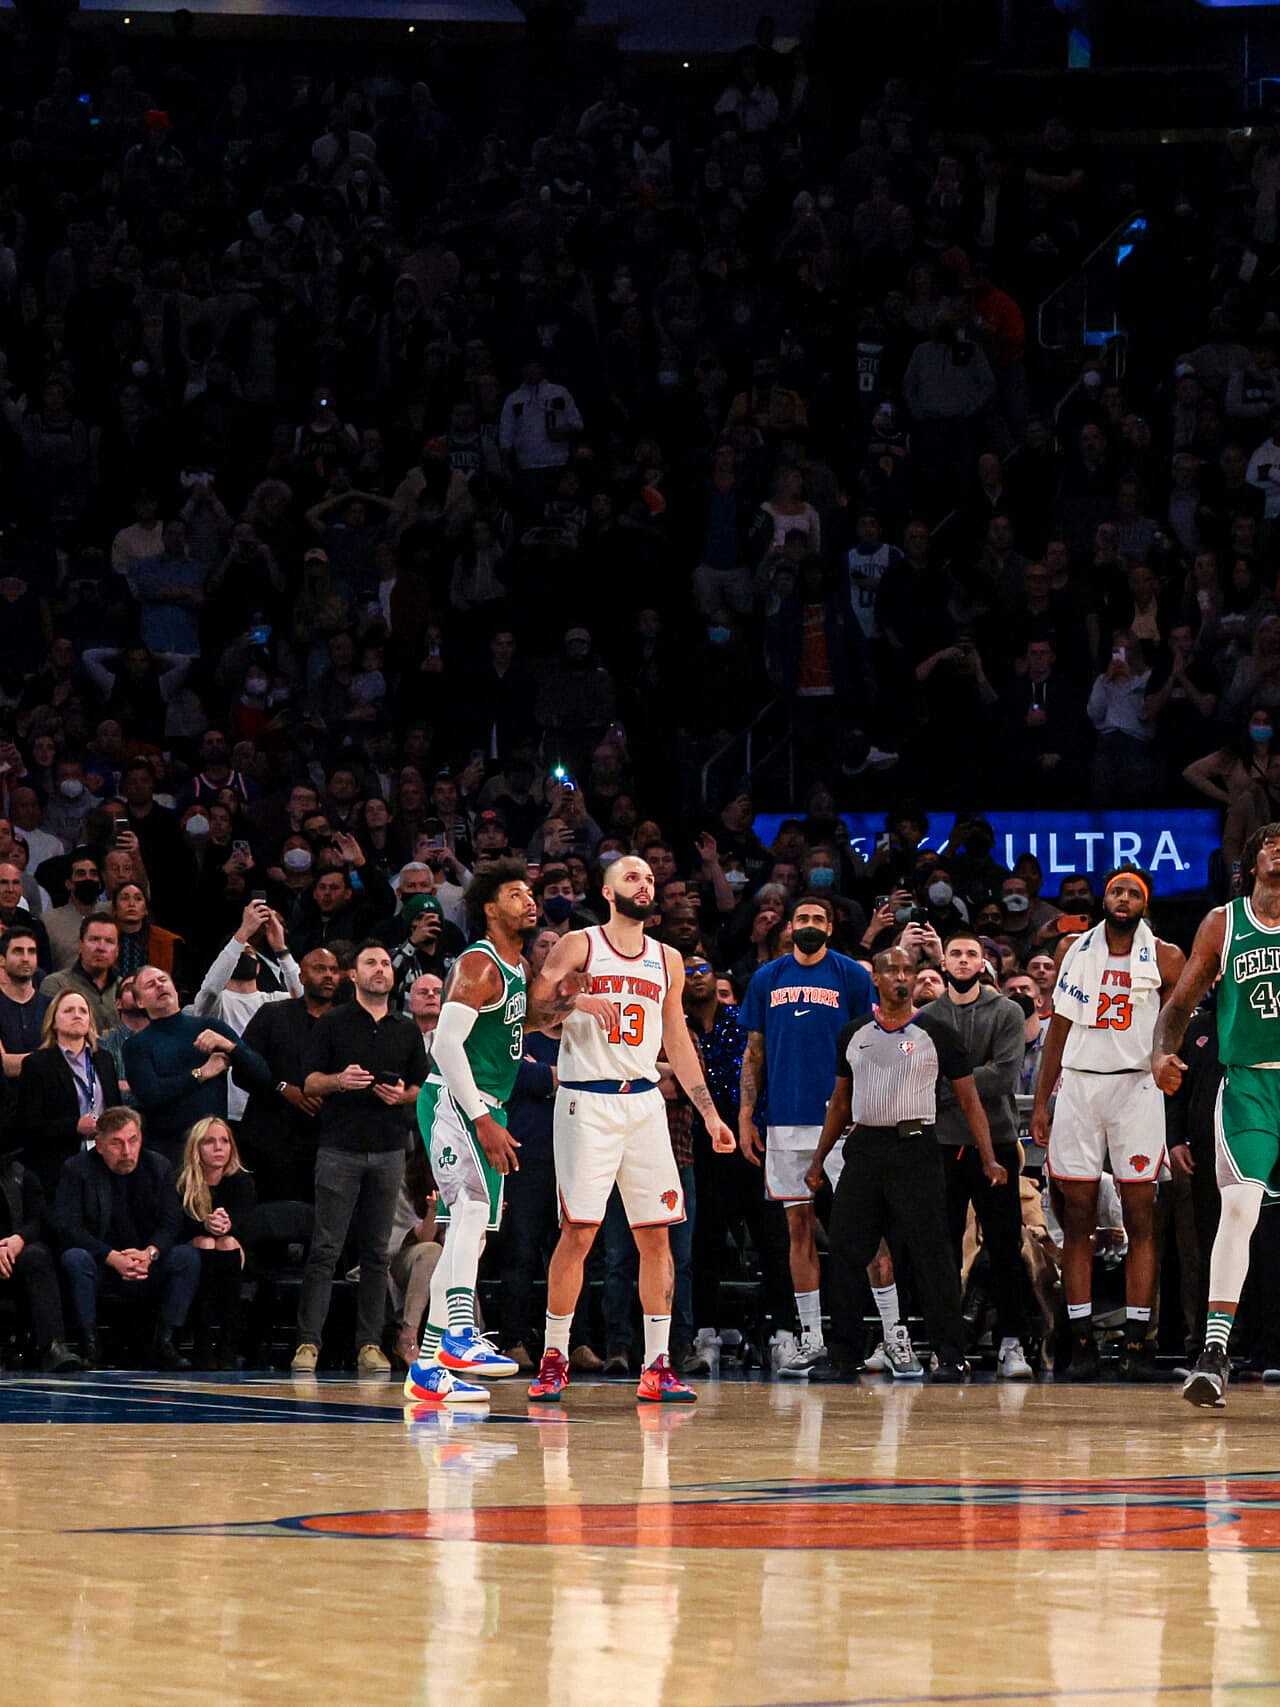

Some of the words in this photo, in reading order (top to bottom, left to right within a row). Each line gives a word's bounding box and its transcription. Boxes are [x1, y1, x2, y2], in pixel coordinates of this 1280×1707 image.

[1005, 829, 1184, 873] ULTRA
[591, 975, 625, 994] NEW
[624, 976, 662, 1003] YORK
[770, 987, 801, 1008] NEW
[800, 986, 840, 1008] YORK
[607, 1002, 646, 1047] 13
[1088, 992, 1133, 1031] 23
[510, 1023, 523, 1060] 3
